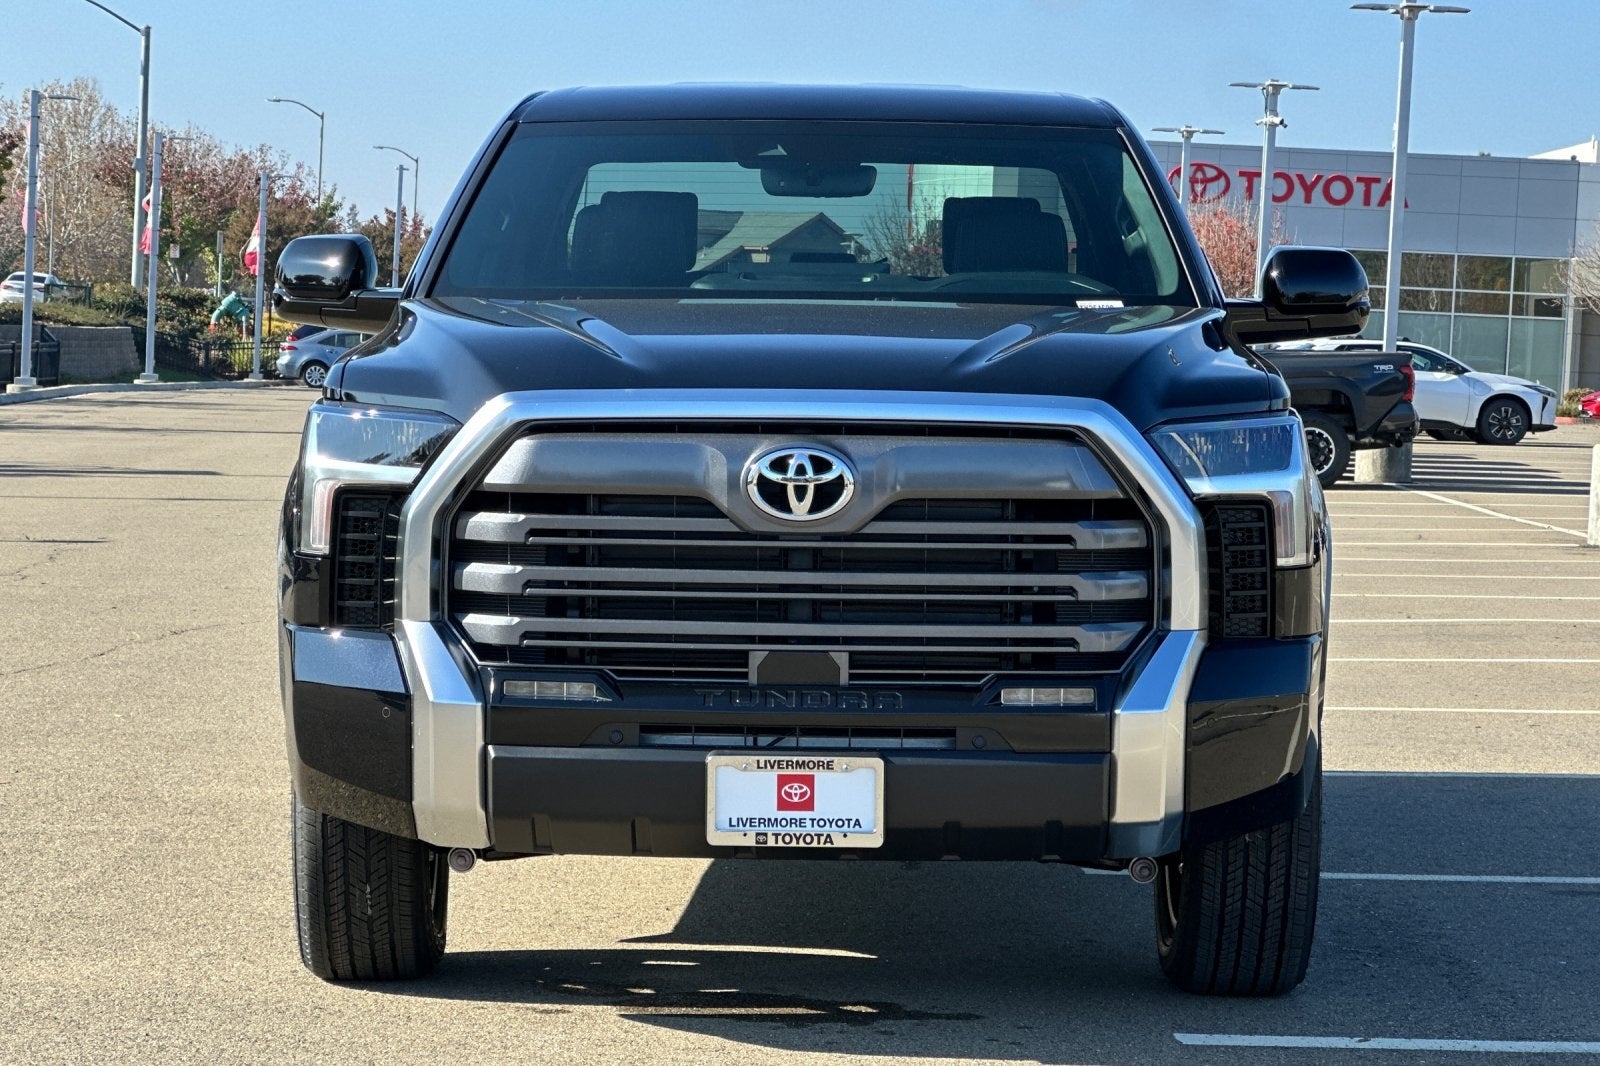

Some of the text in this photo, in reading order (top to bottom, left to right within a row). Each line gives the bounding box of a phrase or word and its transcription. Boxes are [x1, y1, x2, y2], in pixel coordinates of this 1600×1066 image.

[694, 688, 903, 709] TUNDRA
[756, 759, 835, 770] LIVERMORE
[728, 817, 862, 829] LIVERMORE TOYOTA
[771, 832, 835, 846] TOYOTA
